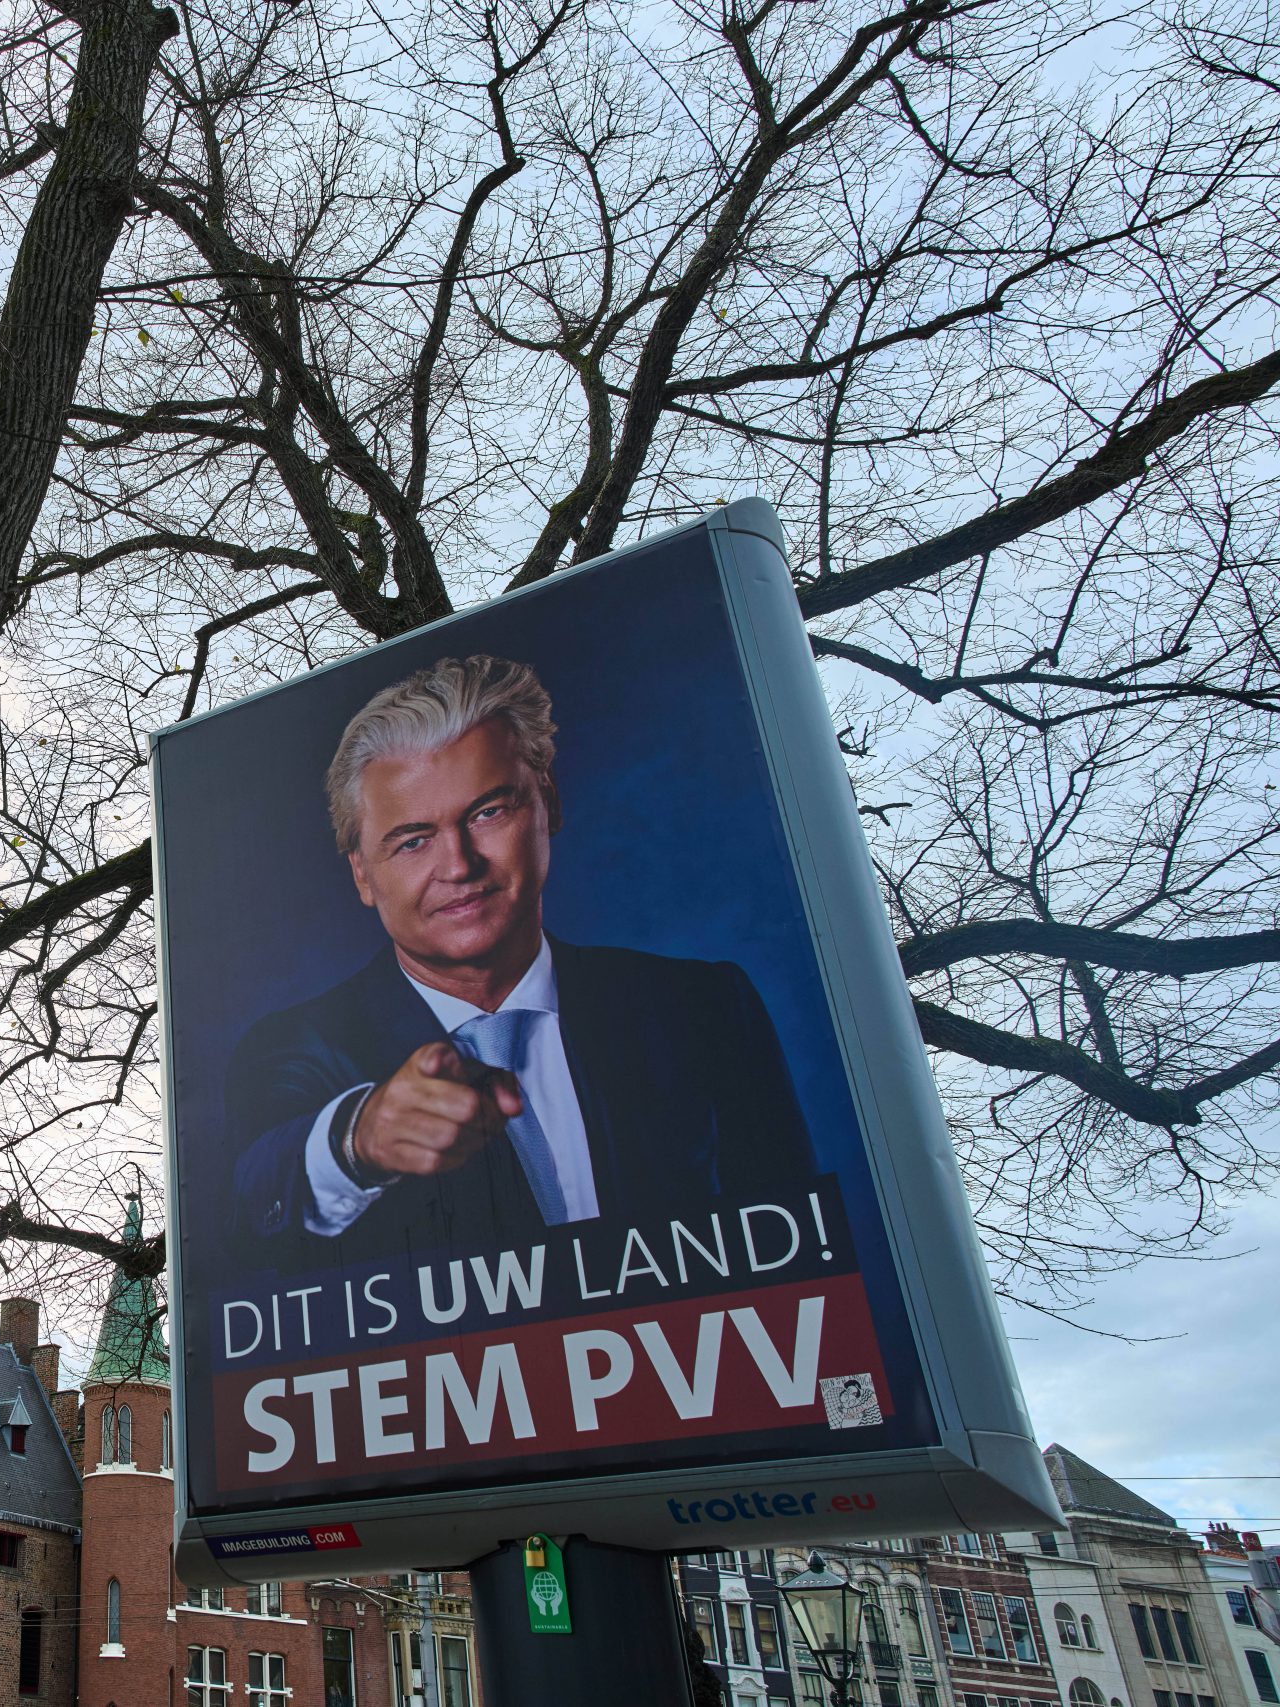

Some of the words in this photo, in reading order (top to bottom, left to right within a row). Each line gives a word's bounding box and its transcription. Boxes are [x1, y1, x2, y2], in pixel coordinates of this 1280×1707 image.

[223, 1285, 323, 1359] DIT
[344, 1272, 399, 1338] IS
[417, 1244, 546, 1324] UW
[571, 1192, 834, 1300] LAND!
[243, 1342, 537, 1474] STEM
[562, 1295, 826, 1433] PVV
